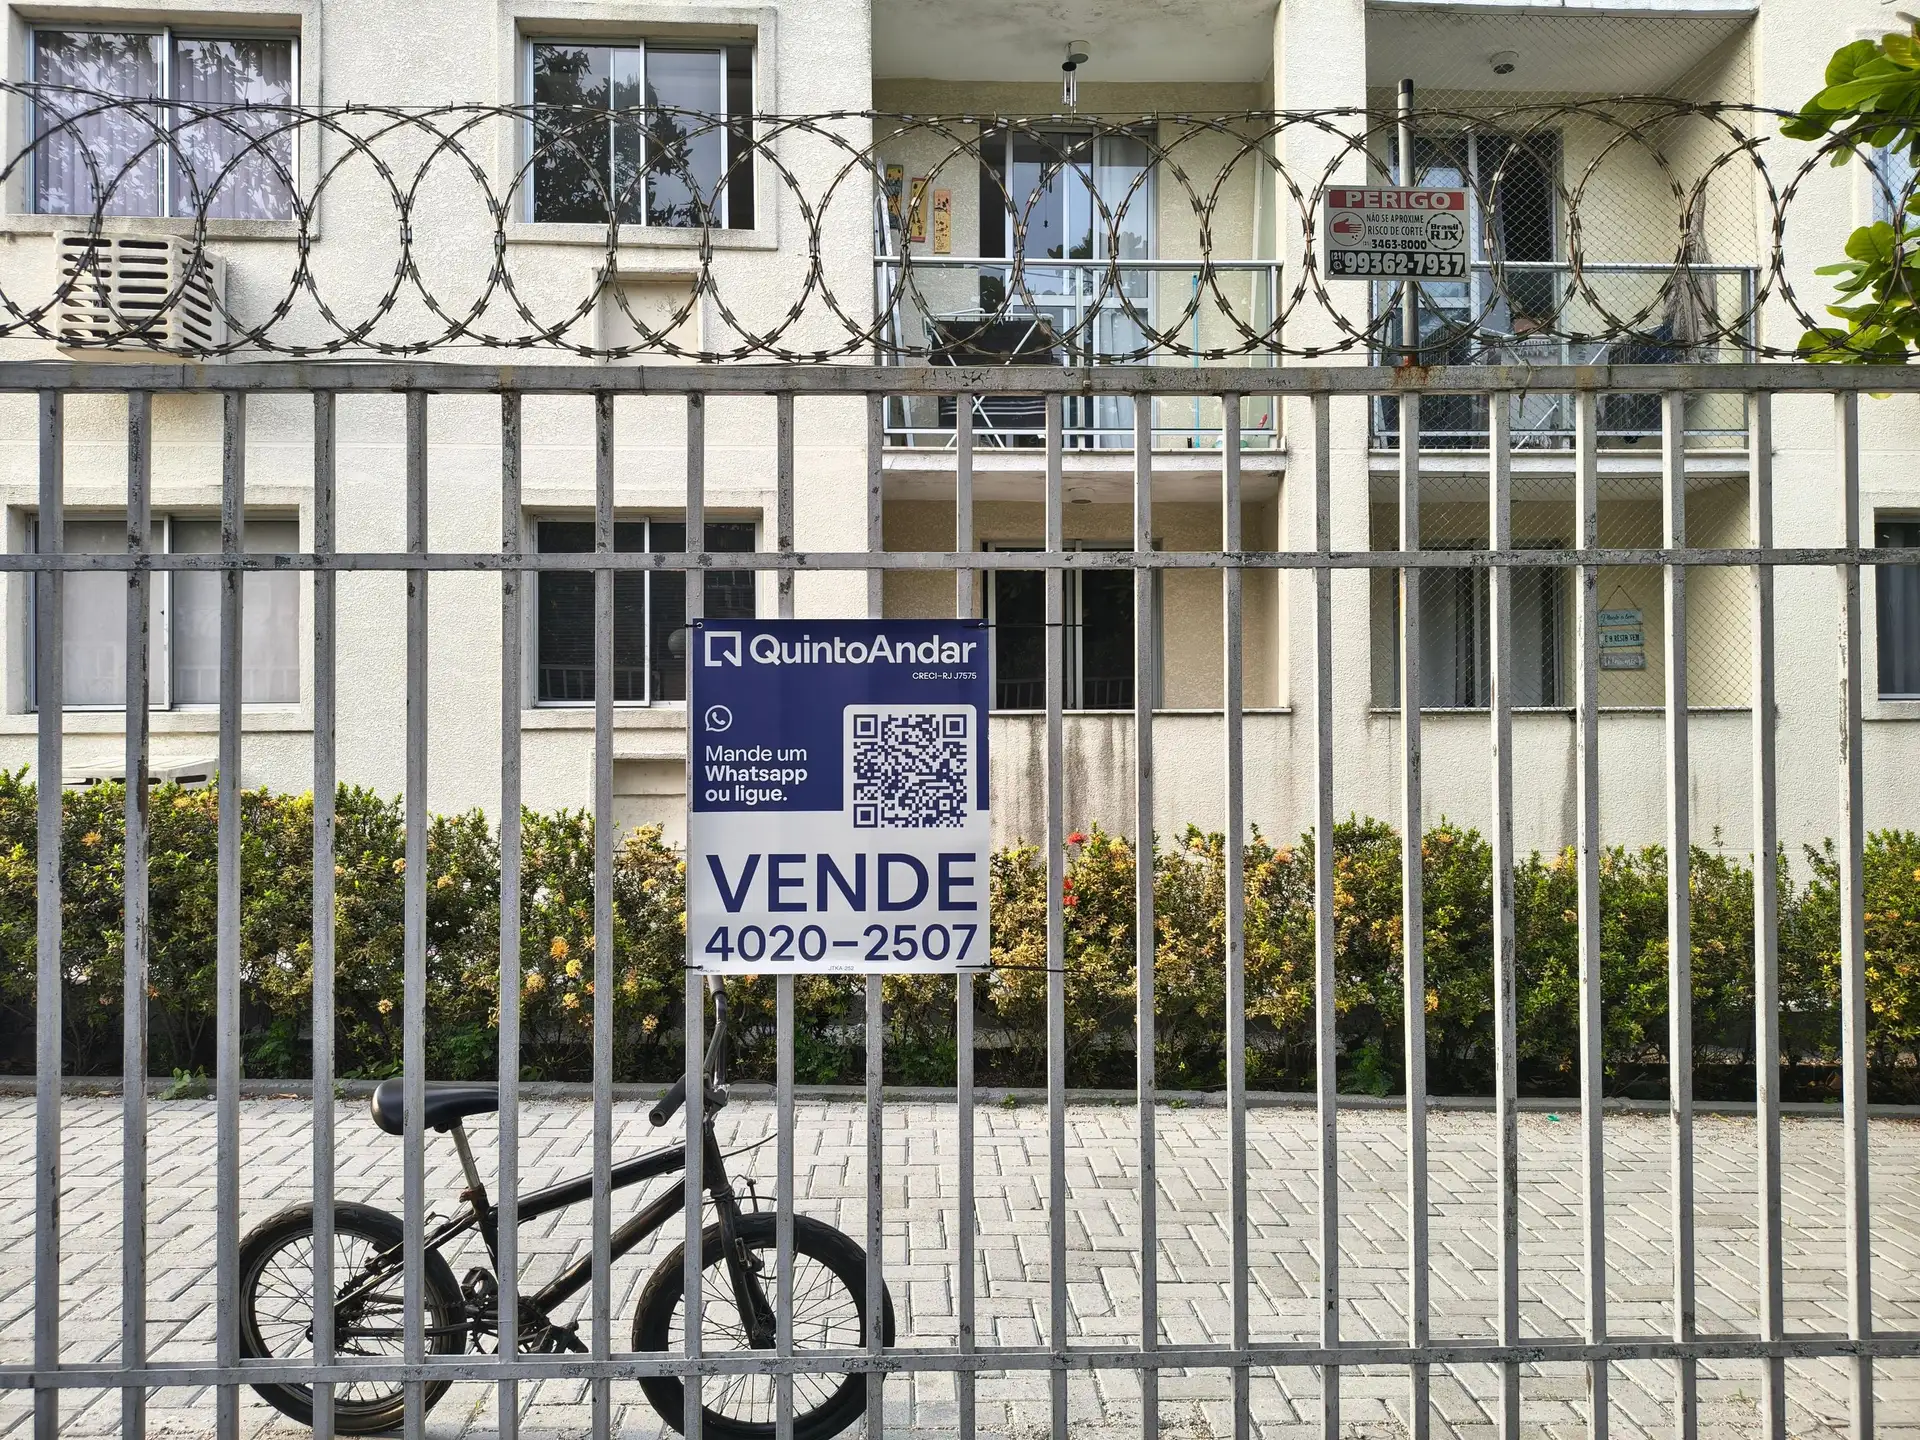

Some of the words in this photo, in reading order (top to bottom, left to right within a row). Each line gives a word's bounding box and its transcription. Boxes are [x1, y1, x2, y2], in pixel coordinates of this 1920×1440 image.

[1345, 191, 1451, 209] PERIGO
[1366, 212, 1379, 222] NÃO
[1382, 214, 1389, 223] SE
[1390, 214, 1424, 223] APROXIME
[1368, 226, 1388, 236] RISCO
[1390, 226, 1399, 236] DE
[1401, 226, 1423, 236] CORTE
[1430, 230, 1459, 241] RJX
[1371, 239, 1427, 249] 3463-8000
[1331, 251, 1345, 261] (21)
[1344, 252, 1464, 276] 99362-7937
[749, 633, 977, 666] QuintoAndar
[953, 671, 977, 680] J7575
[705, 745, 772, 762] Mande
[777, 748, 807, 762] um
[705, 766, 808, 785] Whatsapp
[705, 789, 730, 802] ou
[735, 785, 788, 806] ligue.
[705, 852, 978, 913] VENDE
[705, 923, 978, 963] 4020-2507
